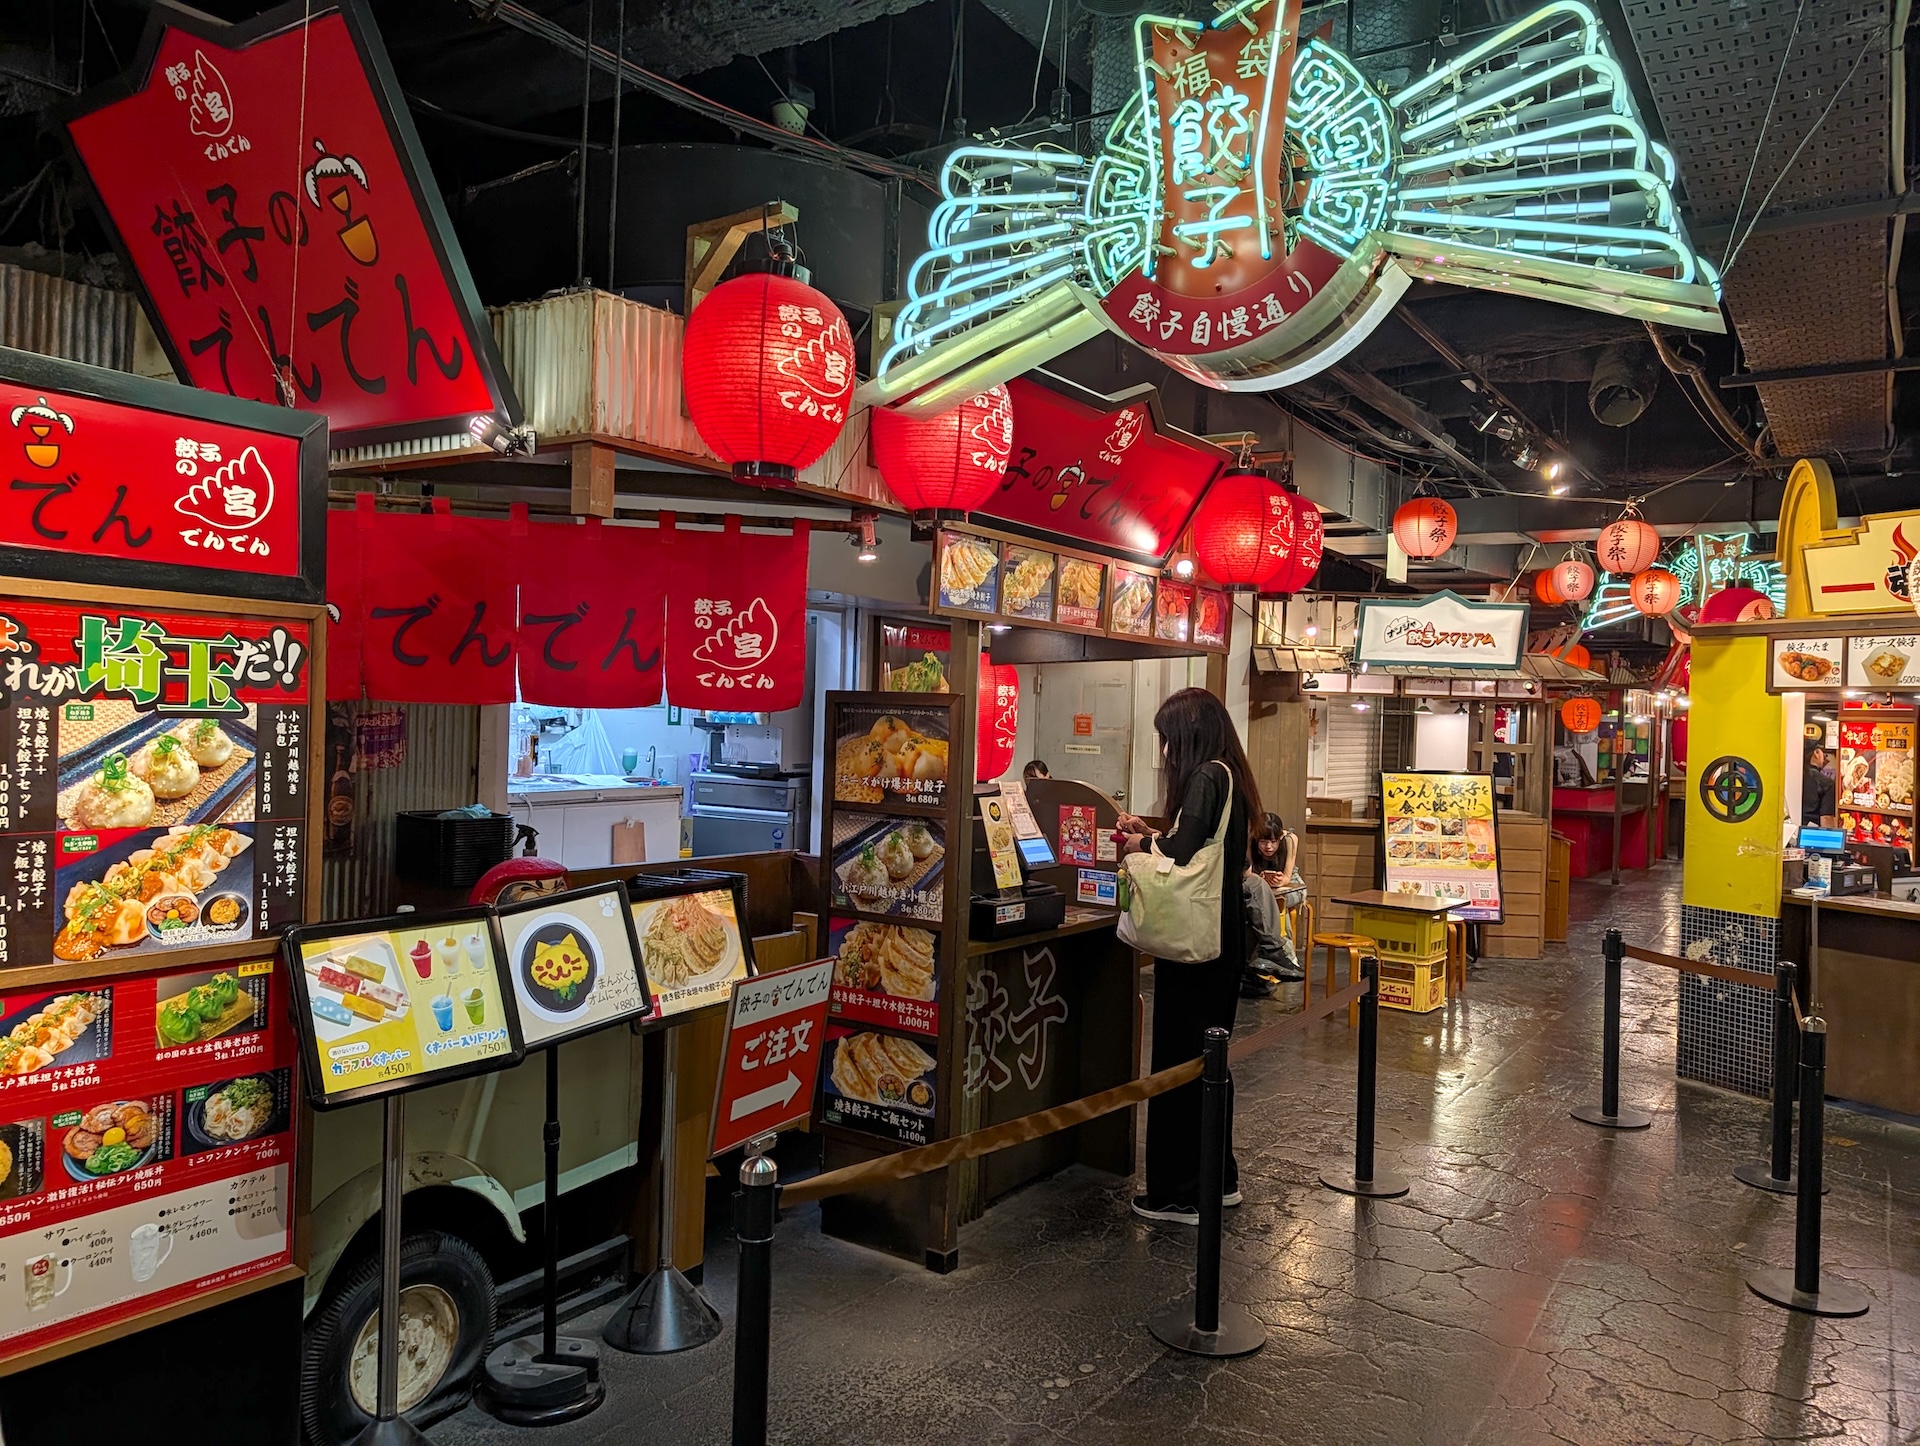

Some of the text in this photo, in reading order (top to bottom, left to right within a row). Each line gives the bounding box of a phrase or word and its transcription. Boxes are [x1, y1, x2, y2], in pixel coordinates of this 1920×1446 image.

[204, 134, 251, 162] でんでん
[1168, 86, 1252, 268] 餃子
[778, 304, 824, 327] 餃子
[1128, 271, 1314, 346] 餃子自慢通り
[190, 274, 463, 404] でんでん
[780, 322, 802, 338] の
[776, 391, 843, 424] でんでん
[175, 437, 221, 463] 餃子
[176, 458, 198, 477] の
[223, 485, 257, 518] 宮
[1429, 501, 1449, 542] 餃子祭
[178, 528, 271, 556] でんでん
[1607, 523, 1628, 561] 餃子祭
[1566, 565, 1580, 592] 餃子祭
[1643, 573, 1661, 604] 餃子祭
[694, 598, 733, 616] 餃子
[695, 614, 712, 630] の
[1406, 621, 1497, 649] 餃子スタジアム
[1866, 636, 1917, 648] チーズ餃子
[733, 632, 763, 659] 宮
[1786, 641, 1829, 652] 餃子ったま
[696, 672, 774, 689] でんでん
[997, 697, 1008, 707] の
[275, 710, 287, 747] 小籠包
[288, 710, 300, 794] 小江戸川越焼き
[16, 707, 33, 819] 坦々水餃子セット
[840, 776, 946, 795] チーズがけ爆汁丸餃子
[1387, 780, 1489, 799] いろんな餃子を
[917, 794, 940, 806] 680円
[273, 826, 285, 887] ご飯セット
[14, 841, 31, 911] ご飯セット
[260, 872, 273, 931] 1,150円
[838, 882, 938, 908] 小江戸川越焼き小籠包
[912, 904, 935, 917] 580円
[242, 963, 270, 973] 数量限定
[588, 982, 640, 1006] オムにゃイス
[898, 1014, 931, 1031] 1,000円
[230, 1045, 264, 1058] 1,200円
[740, 1018, 814, 1071] ご注文
[378, 1062, 412, 1078] 各450円
[69, 1075, 101, 1090] 550円
[898, 1128, 927, 1145] 1,100円
[188, 1139, 276, 1166] ミニワンタンラーメン
[256, 1148, 281, 1161] 700円
[95, 1165, 164, 1190] 秘伝タレ焼豚丼
[134, 1178, 162, 1192] 650円
[230, 1174, 268, 1190] カクテル
[236, 1186, 279, 1202] モスコミュール
[0, 1212, 31, 1227] 650円
[162, 1219, 213, 1238] フルーツサワー
[43, 1226, 79, 1241] サワー
[70, 1228, 108, 1244] ハイボール
[89, 1237, 114, 1248] 400円
[71, 1247, 114, 1265] ウーロンハイ
[88, 1256, 113, 1268] 440円
